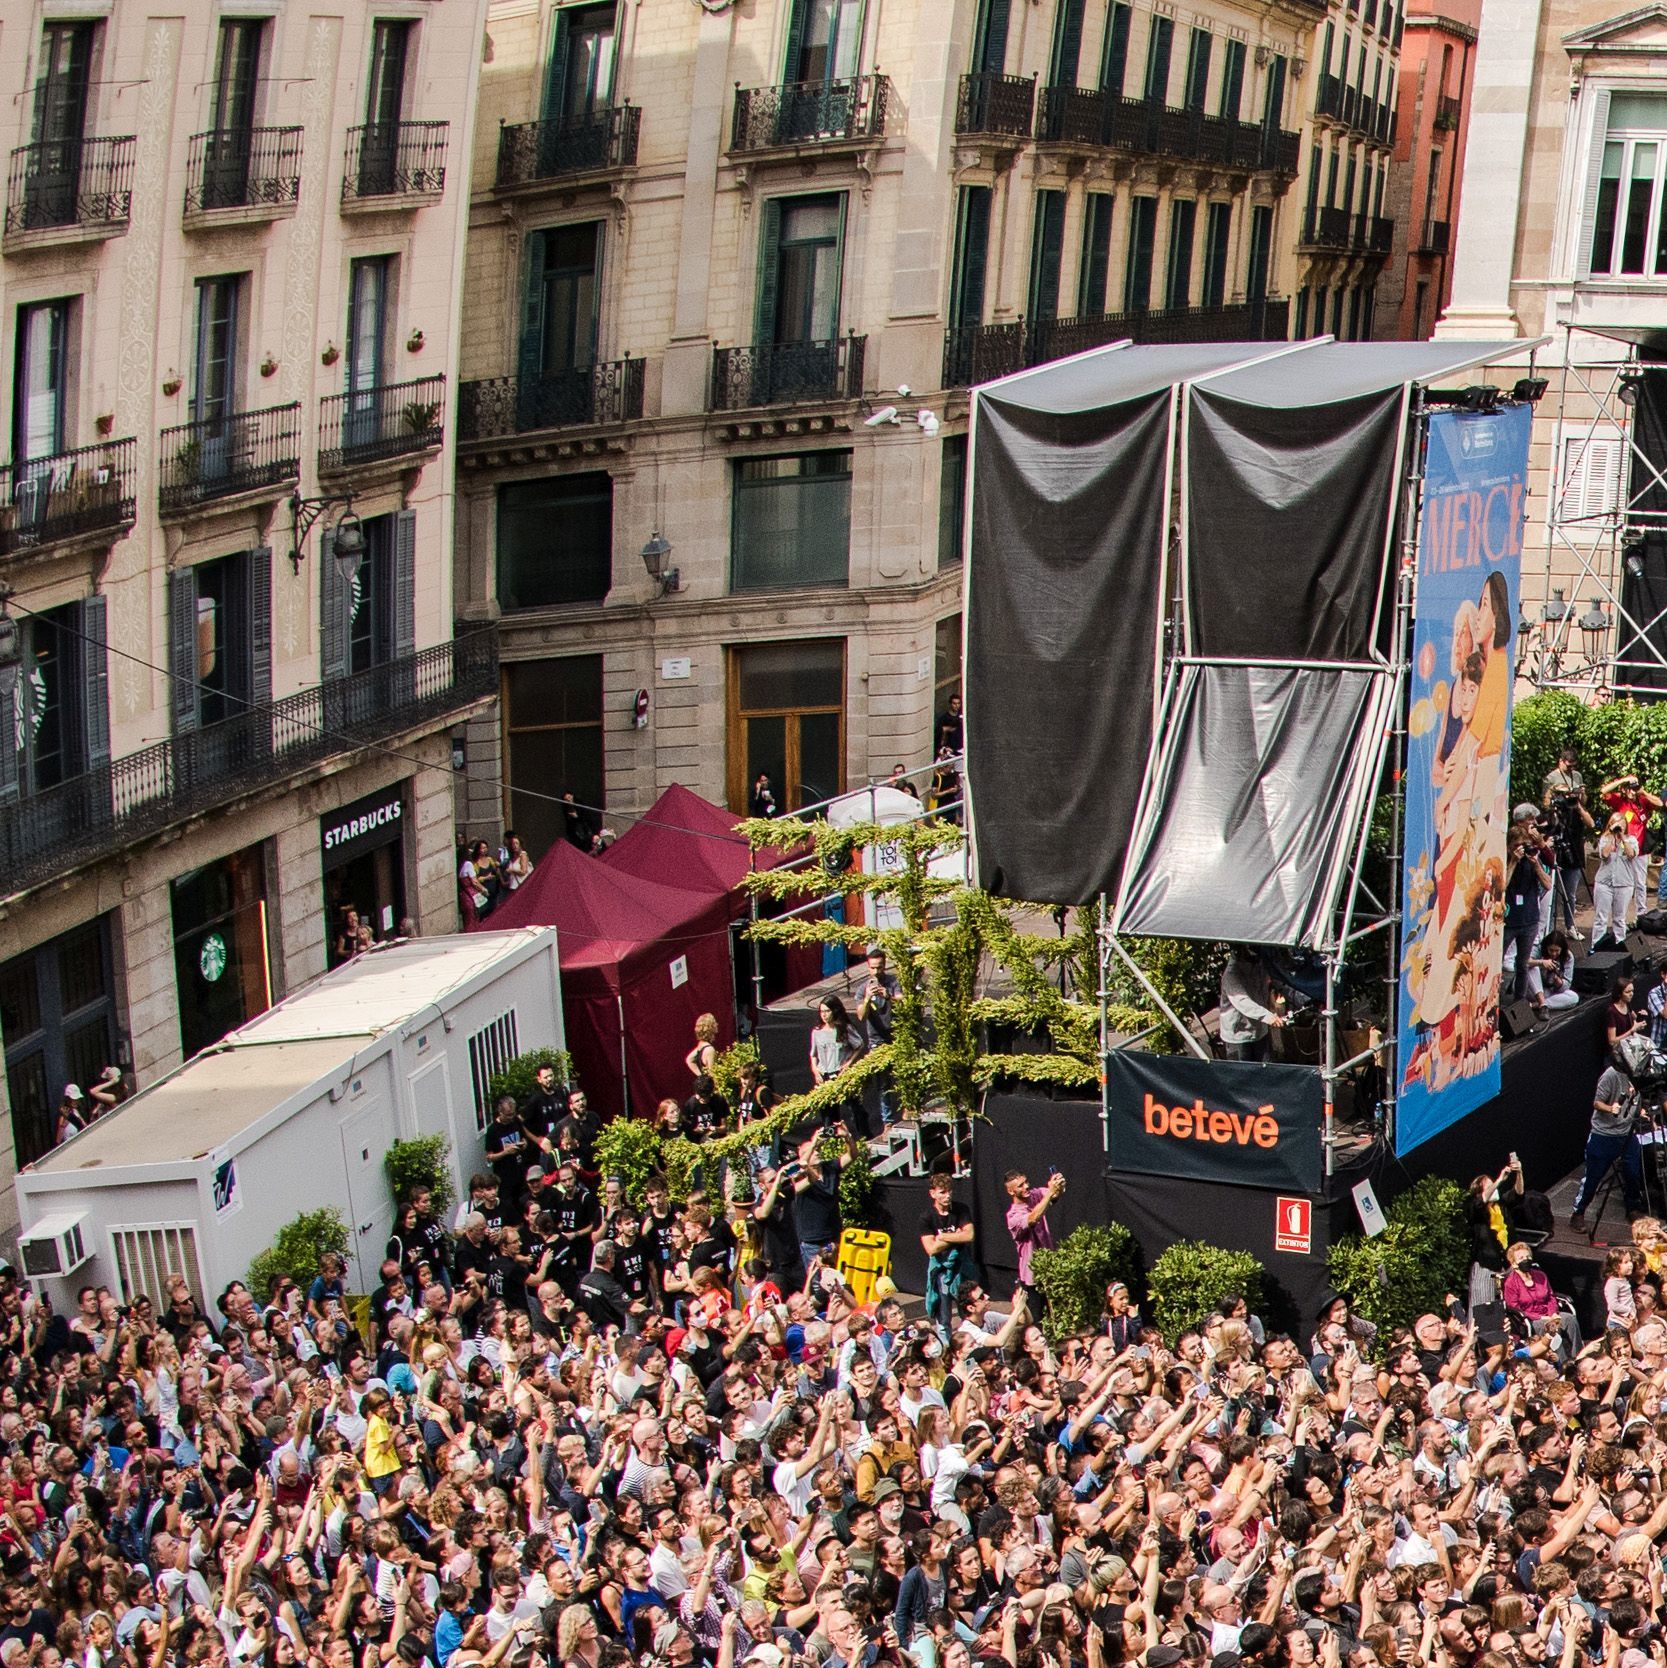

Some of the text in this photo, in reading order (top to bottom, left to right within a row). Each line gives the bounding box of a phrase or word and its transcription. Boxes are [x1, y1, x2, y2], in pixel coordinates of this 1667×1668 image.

[1423, 473, 1523, 577] MERCÈ
[325, 801, 401, 849] STARBUCKS
[881, 855, 897, 865] TOI
[1143, 1094, 1279, 1148] betevé
